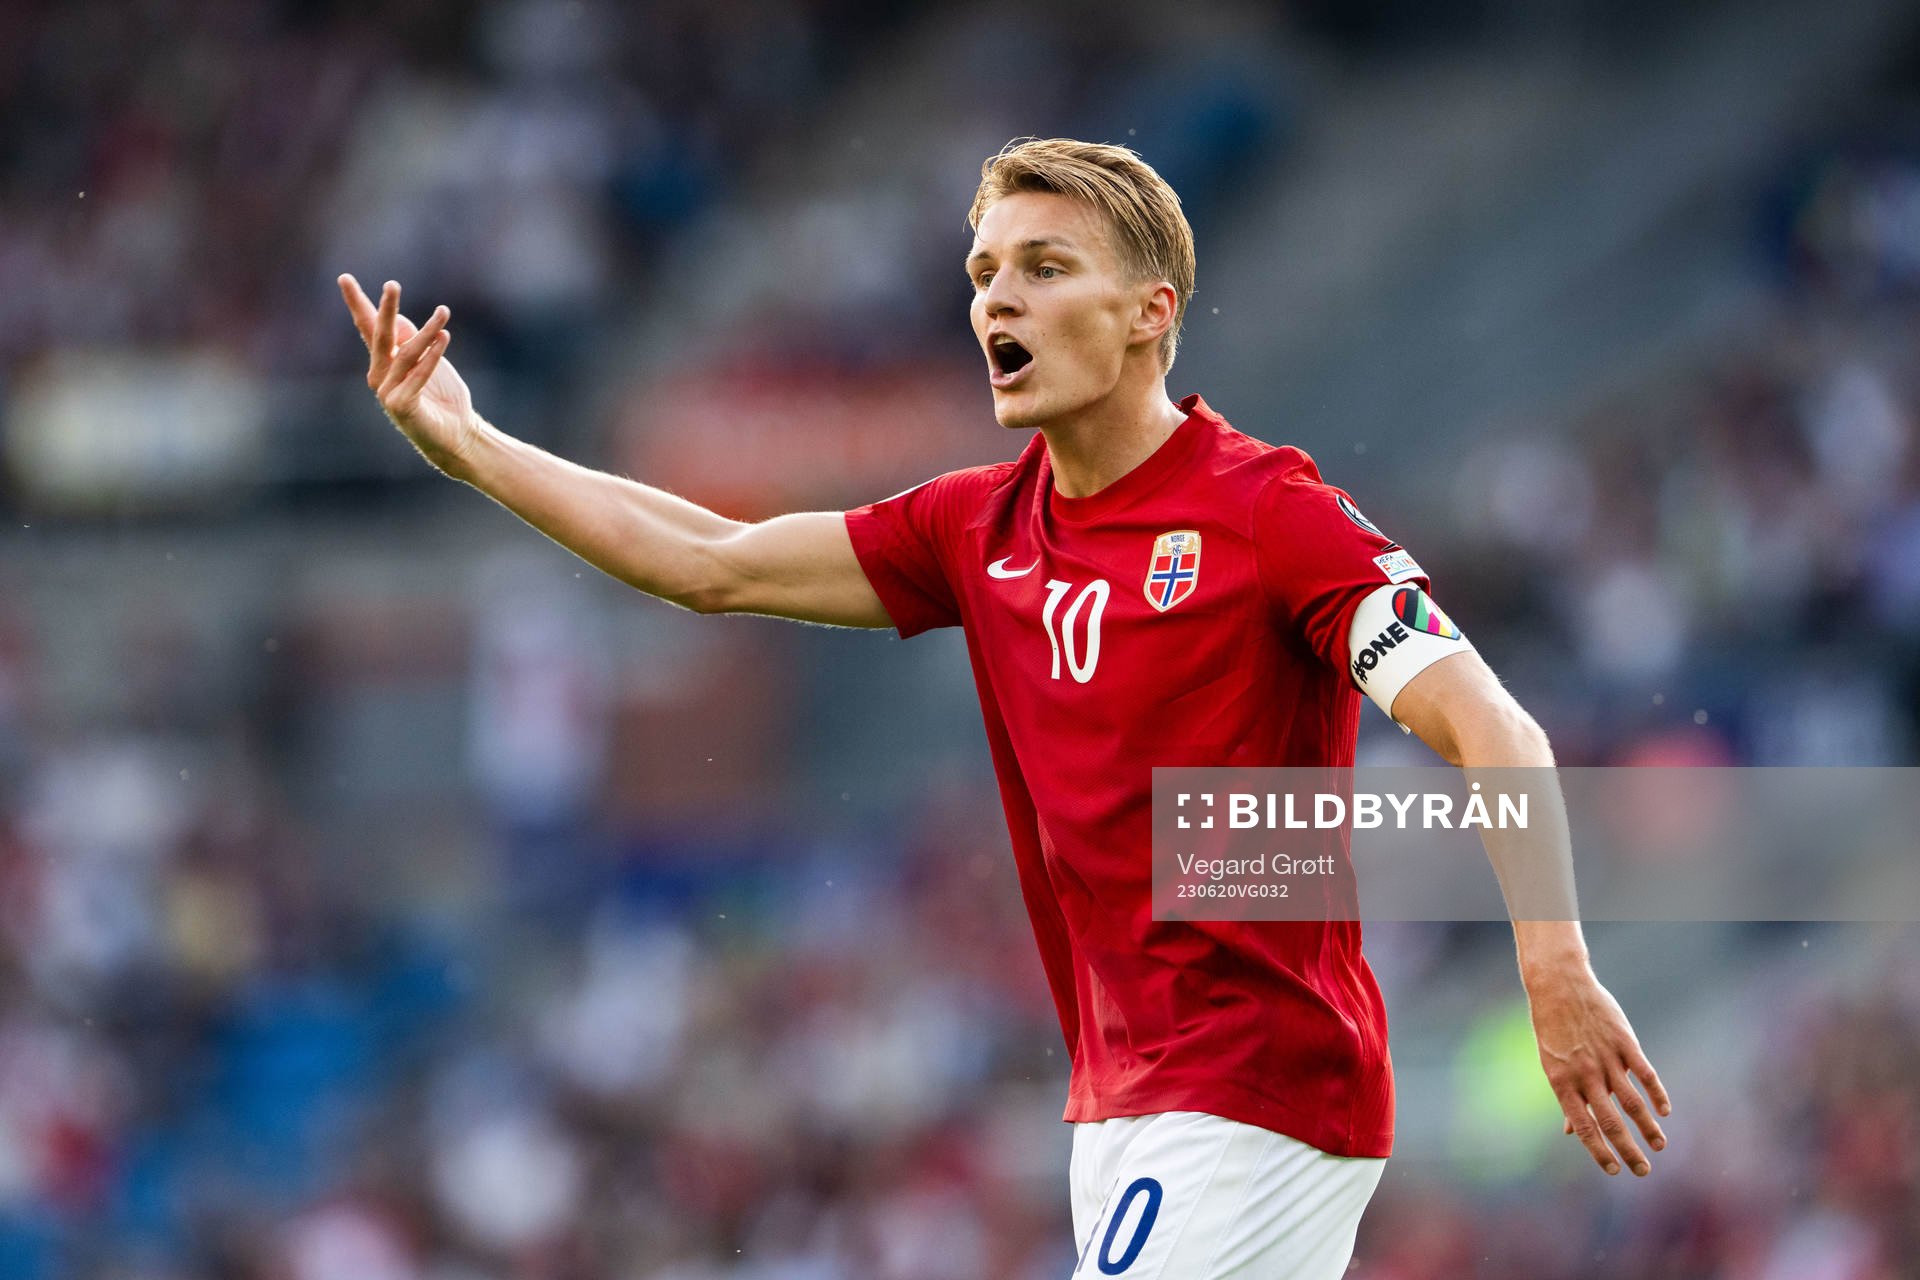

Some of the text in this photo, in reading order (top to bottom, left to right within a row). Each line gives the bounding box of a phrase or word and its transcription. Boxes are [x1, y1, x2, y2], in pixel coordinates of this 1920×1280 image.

[1042, 578, 1110, 684] 10
[1352, 621, 1409, 685] #ONE
[1076, 1176, 1163, 1276] 0
